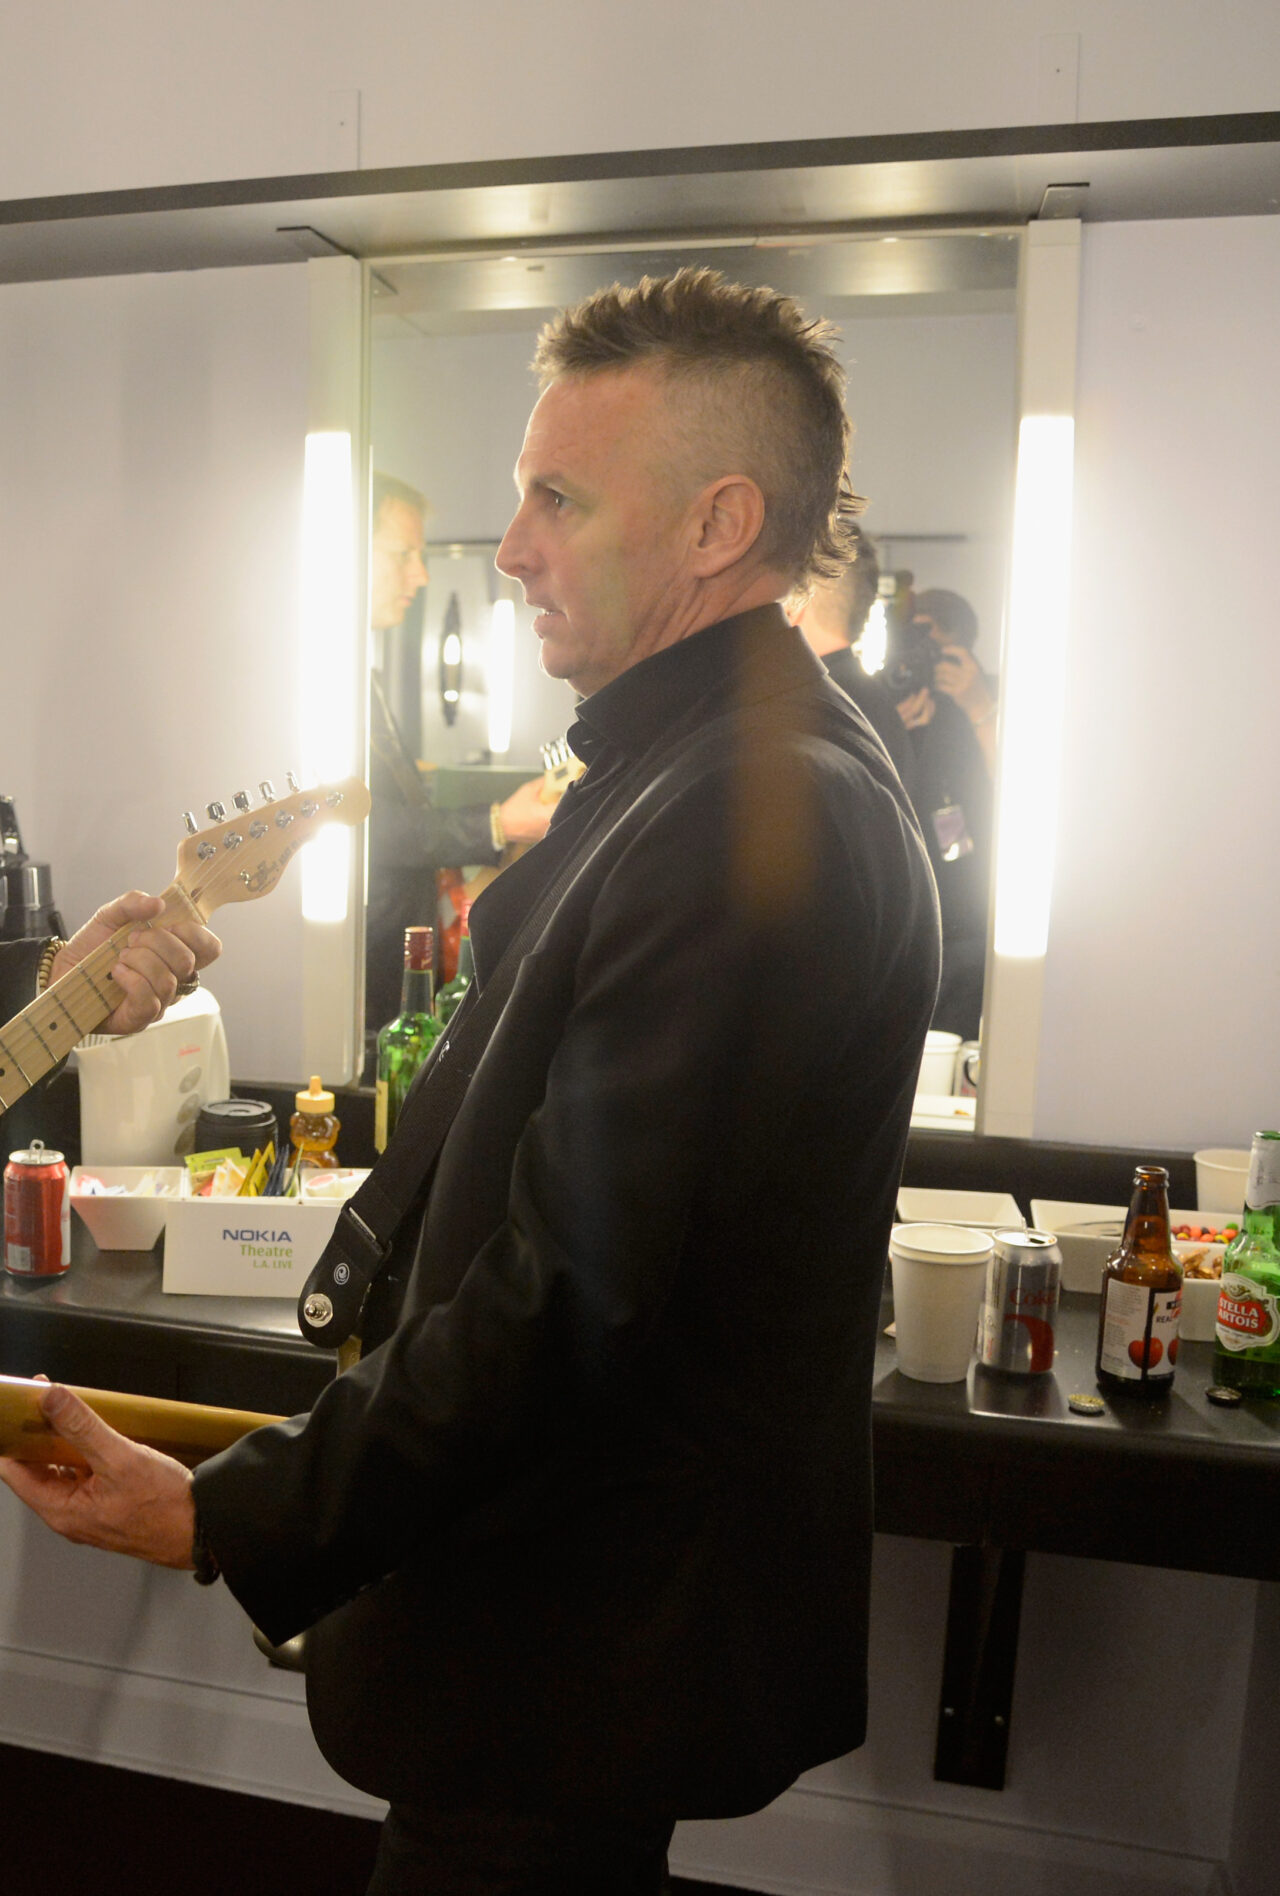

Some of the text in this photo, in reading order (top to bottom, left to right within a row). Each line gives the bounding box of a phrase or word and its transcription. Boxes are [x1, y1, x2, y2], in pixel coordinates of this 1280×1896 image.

[222, 1229, 293, 1242] NOKIA
[240, 1244, 294, 1258] Theatre
[1008, 1287, 1056, 1307] Coke
[1220, 1296, 1259, 1318] STELLA
[1218, 1308, 1259, 1329] ARTOIS
